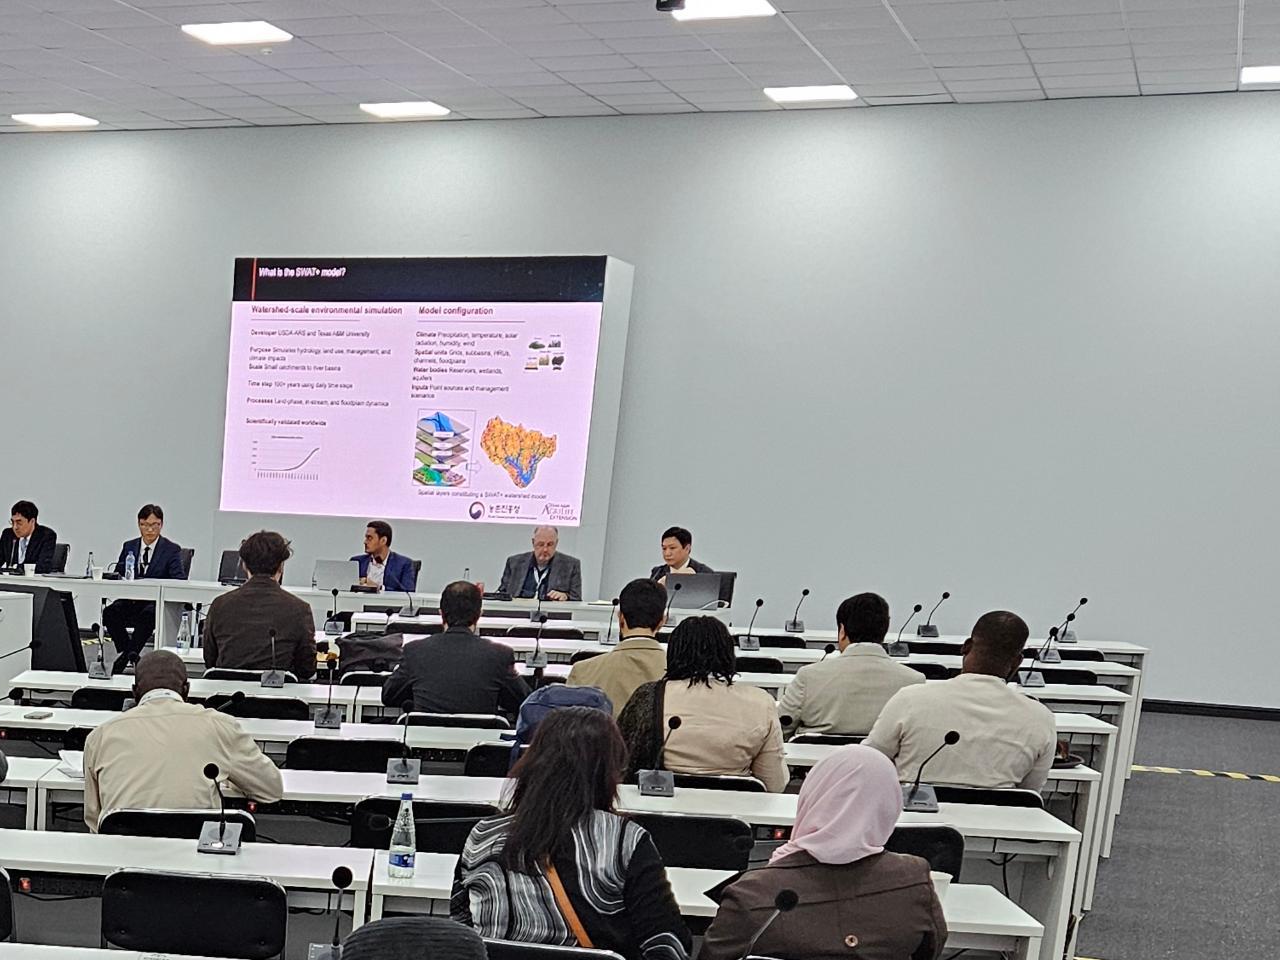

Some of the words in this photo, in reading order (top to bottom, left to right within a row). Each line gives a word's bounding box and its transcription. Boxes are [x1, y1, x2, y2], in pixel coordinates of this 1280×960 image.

[259, 267, 276, 277] What
[277, 267, 283, 277] is
[284, 267, 295, 277] the
[296, 267, 320, 277] SWAT+
[321, 267, 346, 277] model?
[251, 305, 309, 314] Watershed-scale
[311, 306, 362, 314] environmental
[364, 306, 403, 315] simulation
[418, 306, 442, 314] Model
[443, 306, 494, 316] configuration
